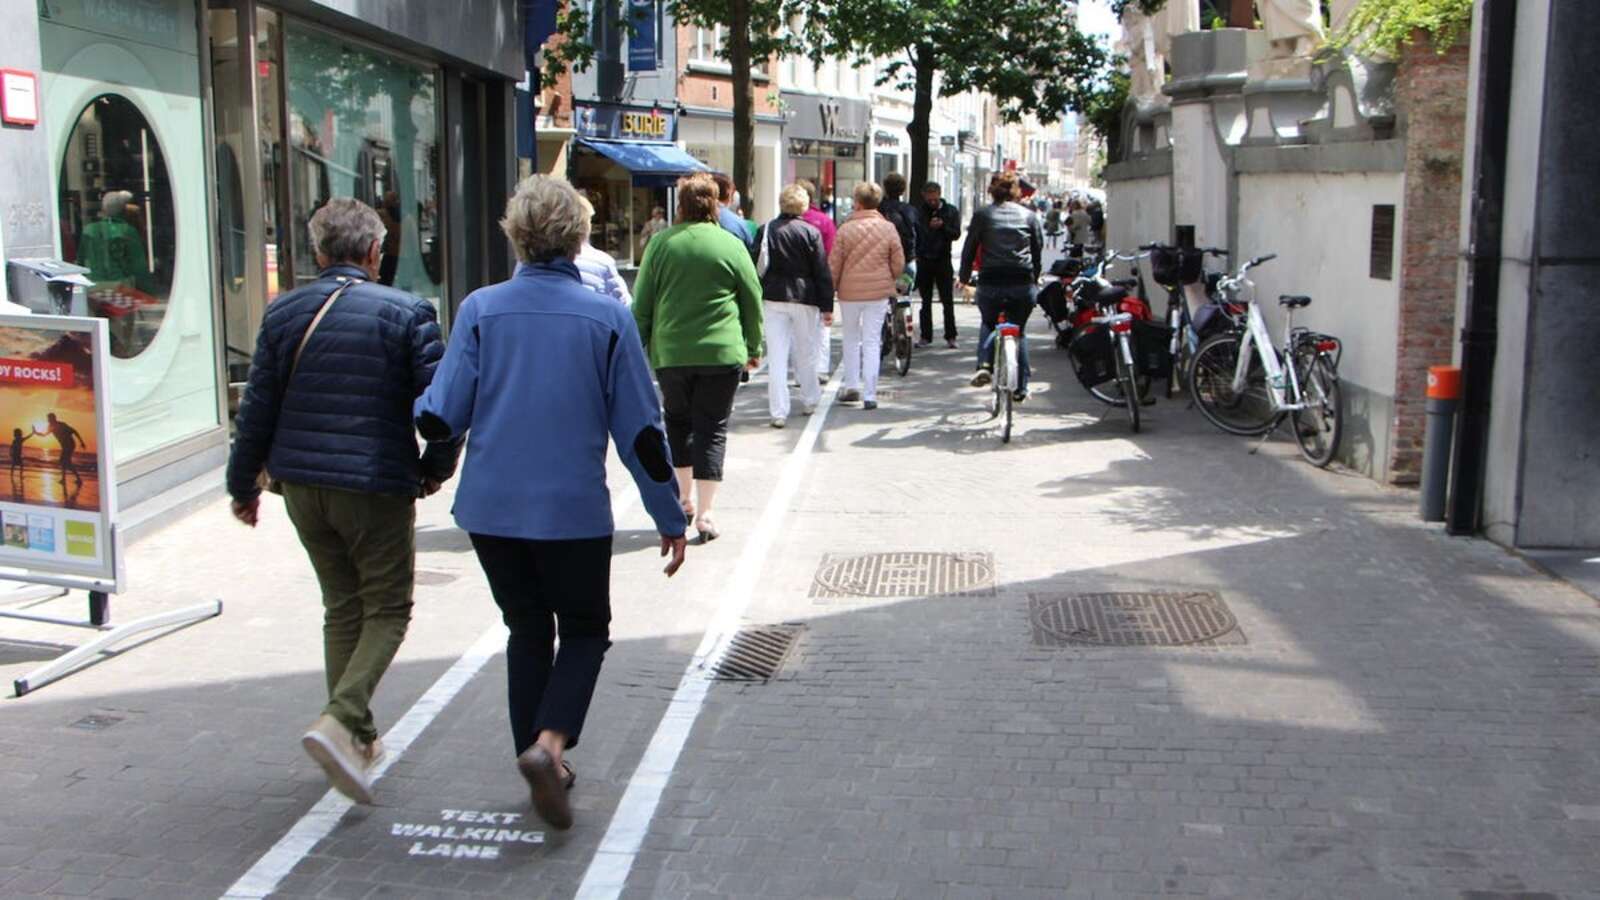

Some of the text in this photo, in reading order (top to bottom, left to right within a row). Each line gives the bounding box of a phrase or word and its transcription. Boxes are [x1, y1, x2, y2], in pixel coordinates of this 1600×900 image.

[622, 112, 666, 135] BURIE
[14, 366, 61, 381] ROCKS!
[440, 809, 522, 824] TEXT
[391, 823, 545, 843] WALKING
[408, 841, 500, 859] LANE
